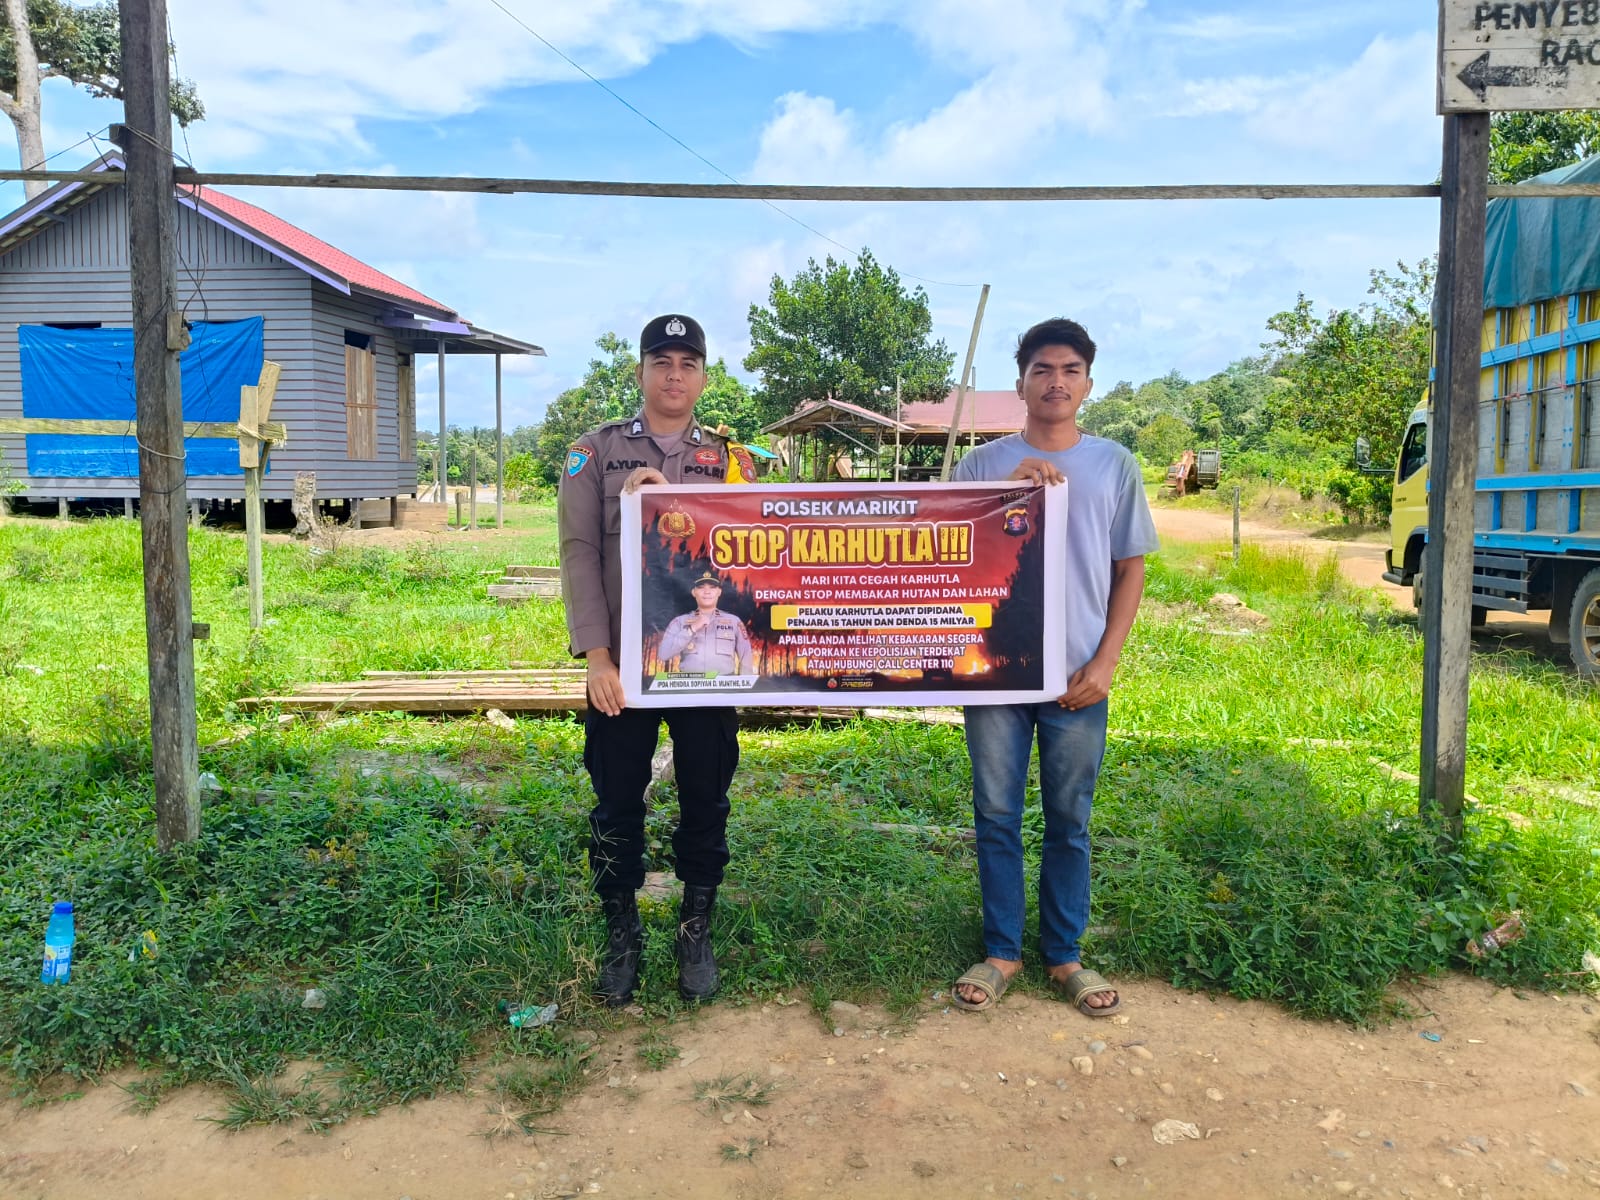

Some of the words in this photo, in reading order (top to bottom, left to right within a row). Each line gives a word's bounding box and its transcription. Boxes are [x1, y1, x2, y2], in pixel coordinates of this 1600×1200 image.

[684, 465, 724, 479] POLRI
[763, 501, 834, 516] POLSEK
[837, 499, 918, 515] MARIKIT
[714, 529, 786, 564] STOP
[791, 526, 934, 564] KARHUTLA
[939, 526, 969, 562] !!!
[801, 575, 831, 585] MARI
[833, 575, 857, 585] KITA
[859, 575, 898, 585] CEGAH
[900, 574, 960, 584] KARHUTLA
[755, 590, 801, 600] DENGAN
[803, 589, 833, 599] STOP
[834, 589, 899, 599] MEMBAKAR
[902, 588, 939, 598] HUTAN
[942, 588, 967, 598] DAN
[969, 588, 1008, 598] LAHAN
[798, 607, 833, 616] PELAKU
[835, 607, 884, 616] KARHUTLA
[885, 606, 915, 616] DAPAT
[917, 606, 962, 615] DIPIDANA
[787, 618, 829, 627] PENJARA
[831, 618, 839, 627] 15
[841, 617, 872, 627] TAHUN
[874, 617, 894, 627] DAN
[896, 617, 928, 627] DENDA
[929, 617, 938, 626] 15
[940, 616, 974, 626] MILYAR
[778, 635, 818, 645] APABILA
[819, 635, 845, 645] ANDA
[847, 634, 887, 645] MELIHAT
[888, 634, 945, 644] KEBAKARAN
[947, 634, 984, 644] SEGERA
[796, 648, 847, 657] LAPORKAN
[849, 647, 860, 657] KE
[862, 647, 916, 657] KEPOLISIAN
[918, 646, 965, 657] TERDEKAT
[807, 660, 831, 670] ATAU
[833, 660, 877, 670] HUBUNGI
[877, 659, 902, 669] CALL
[902, 659, 939, 669] CENTER
[940, 659, 954, 669] 110
